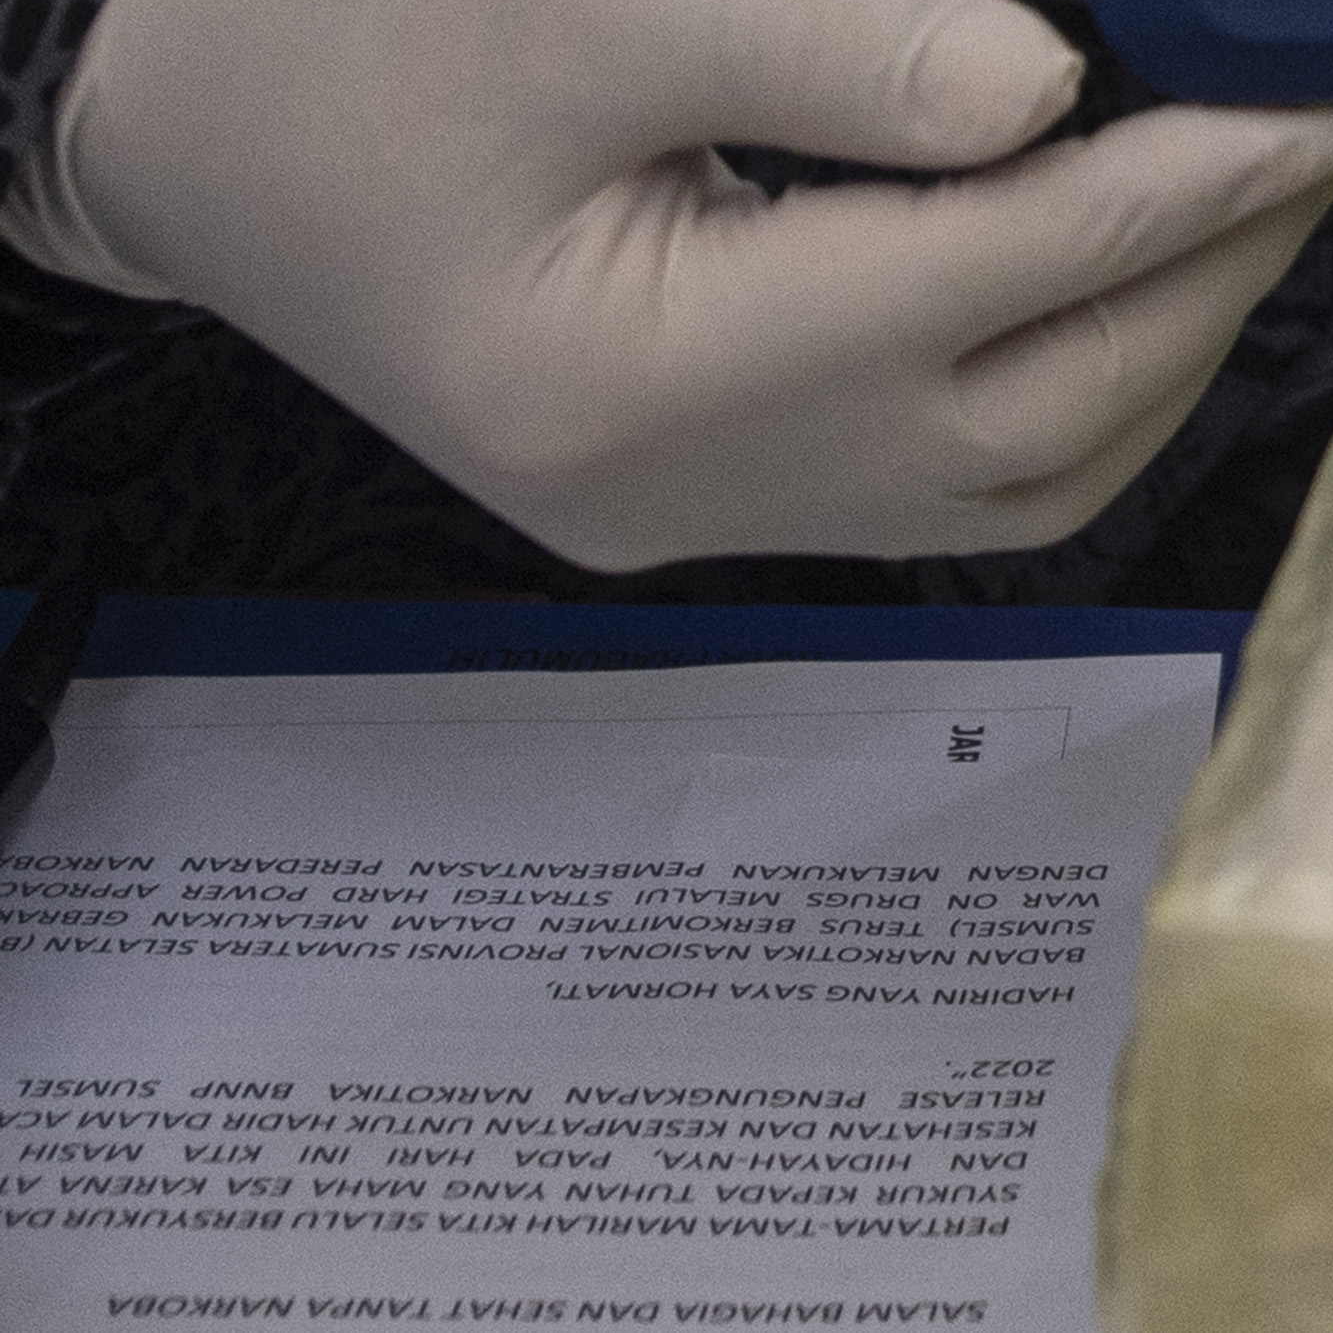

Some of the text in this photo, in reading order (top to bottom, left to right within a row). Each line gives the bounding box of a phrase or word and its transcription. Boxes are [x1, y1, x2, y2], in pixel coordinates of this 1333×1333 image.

[179, 856, 384, 876] PEREDARAN
[408, 860, 706, 880] PEMBERANTASAN
[732, 863, 941, 883] MELAKUKAN
[967, 864, 1109, 882] DENGAN
[180, 884, 309, 903] POWER
[331, 886, 429, 904] HARD
[451, 888, 613, 907] STRATEGI
[634, 887, 782, 908] MELALUI
[807, 891, 922, 911] DRUGS
[947, 892, 999, 911] ON
[1022, 892, 1101, 909] WAR
[151, 911, 369, 931] MELAKUKAN
[390, 915, 516, 933] DALAM
[538, 915, 797, 934] BERKOMITMEN
[820, 918, 923, 938] TERUS
[949, 918, 1095, 938] SUMSEL)
[43, 936, 199, 956] SELATAN
[209, 940, 401, 959] SUMATERA
[406, 943, 569, 962] PROVINSI
[580, 942, 752, 962] NASIONAL
[763, 945, 957, 967] NARKOTIKA
[966, 946, 1087, 966] BADAN
[546, 981, 1076, 1006] HADIRIN YANG SAYA HORMATI,
[19, 1078, 1046, 1110] RELEASE PENGUNGKAPAN NARKOTIKA BNNP SUMSEL
[76, 1110, 213, 1131] DALAM
[222, 1112, 337, 1132] HADIR
[345, 1115, 474, 1136] UNTUK
[485, 1117, 728, 1139] KESEMPATAN
[738, 1120, 818, 1140] DAN
[828, 1120, 1038, 1141] KESEHATAN
[18, 1142, 1029, 1173] DAN HIDAYAH-NYA, PADA HARI INI KITA MASIH
[60, 1175, 208, 1196] KARENA
[227, 1177, 294, 1197] ESA
[312, 1178, 427, 1199] MAHA
[443, 1180, 545, 1201] YANG
[564, 1182, 692, 1204] TUHAN
[715, 1184, 858, 1205] KEPADA
[875, 1183, 1020, 1205] SYUKUR
[0, 1208, 1011, 1238] PERTAMA-TAMA MARILAH KITA SELALU BERSYUKUR DA
[107, 1295, 987, 1324] SALAM BAHAGIA DAN SEHAT TANPA NARKOBA
